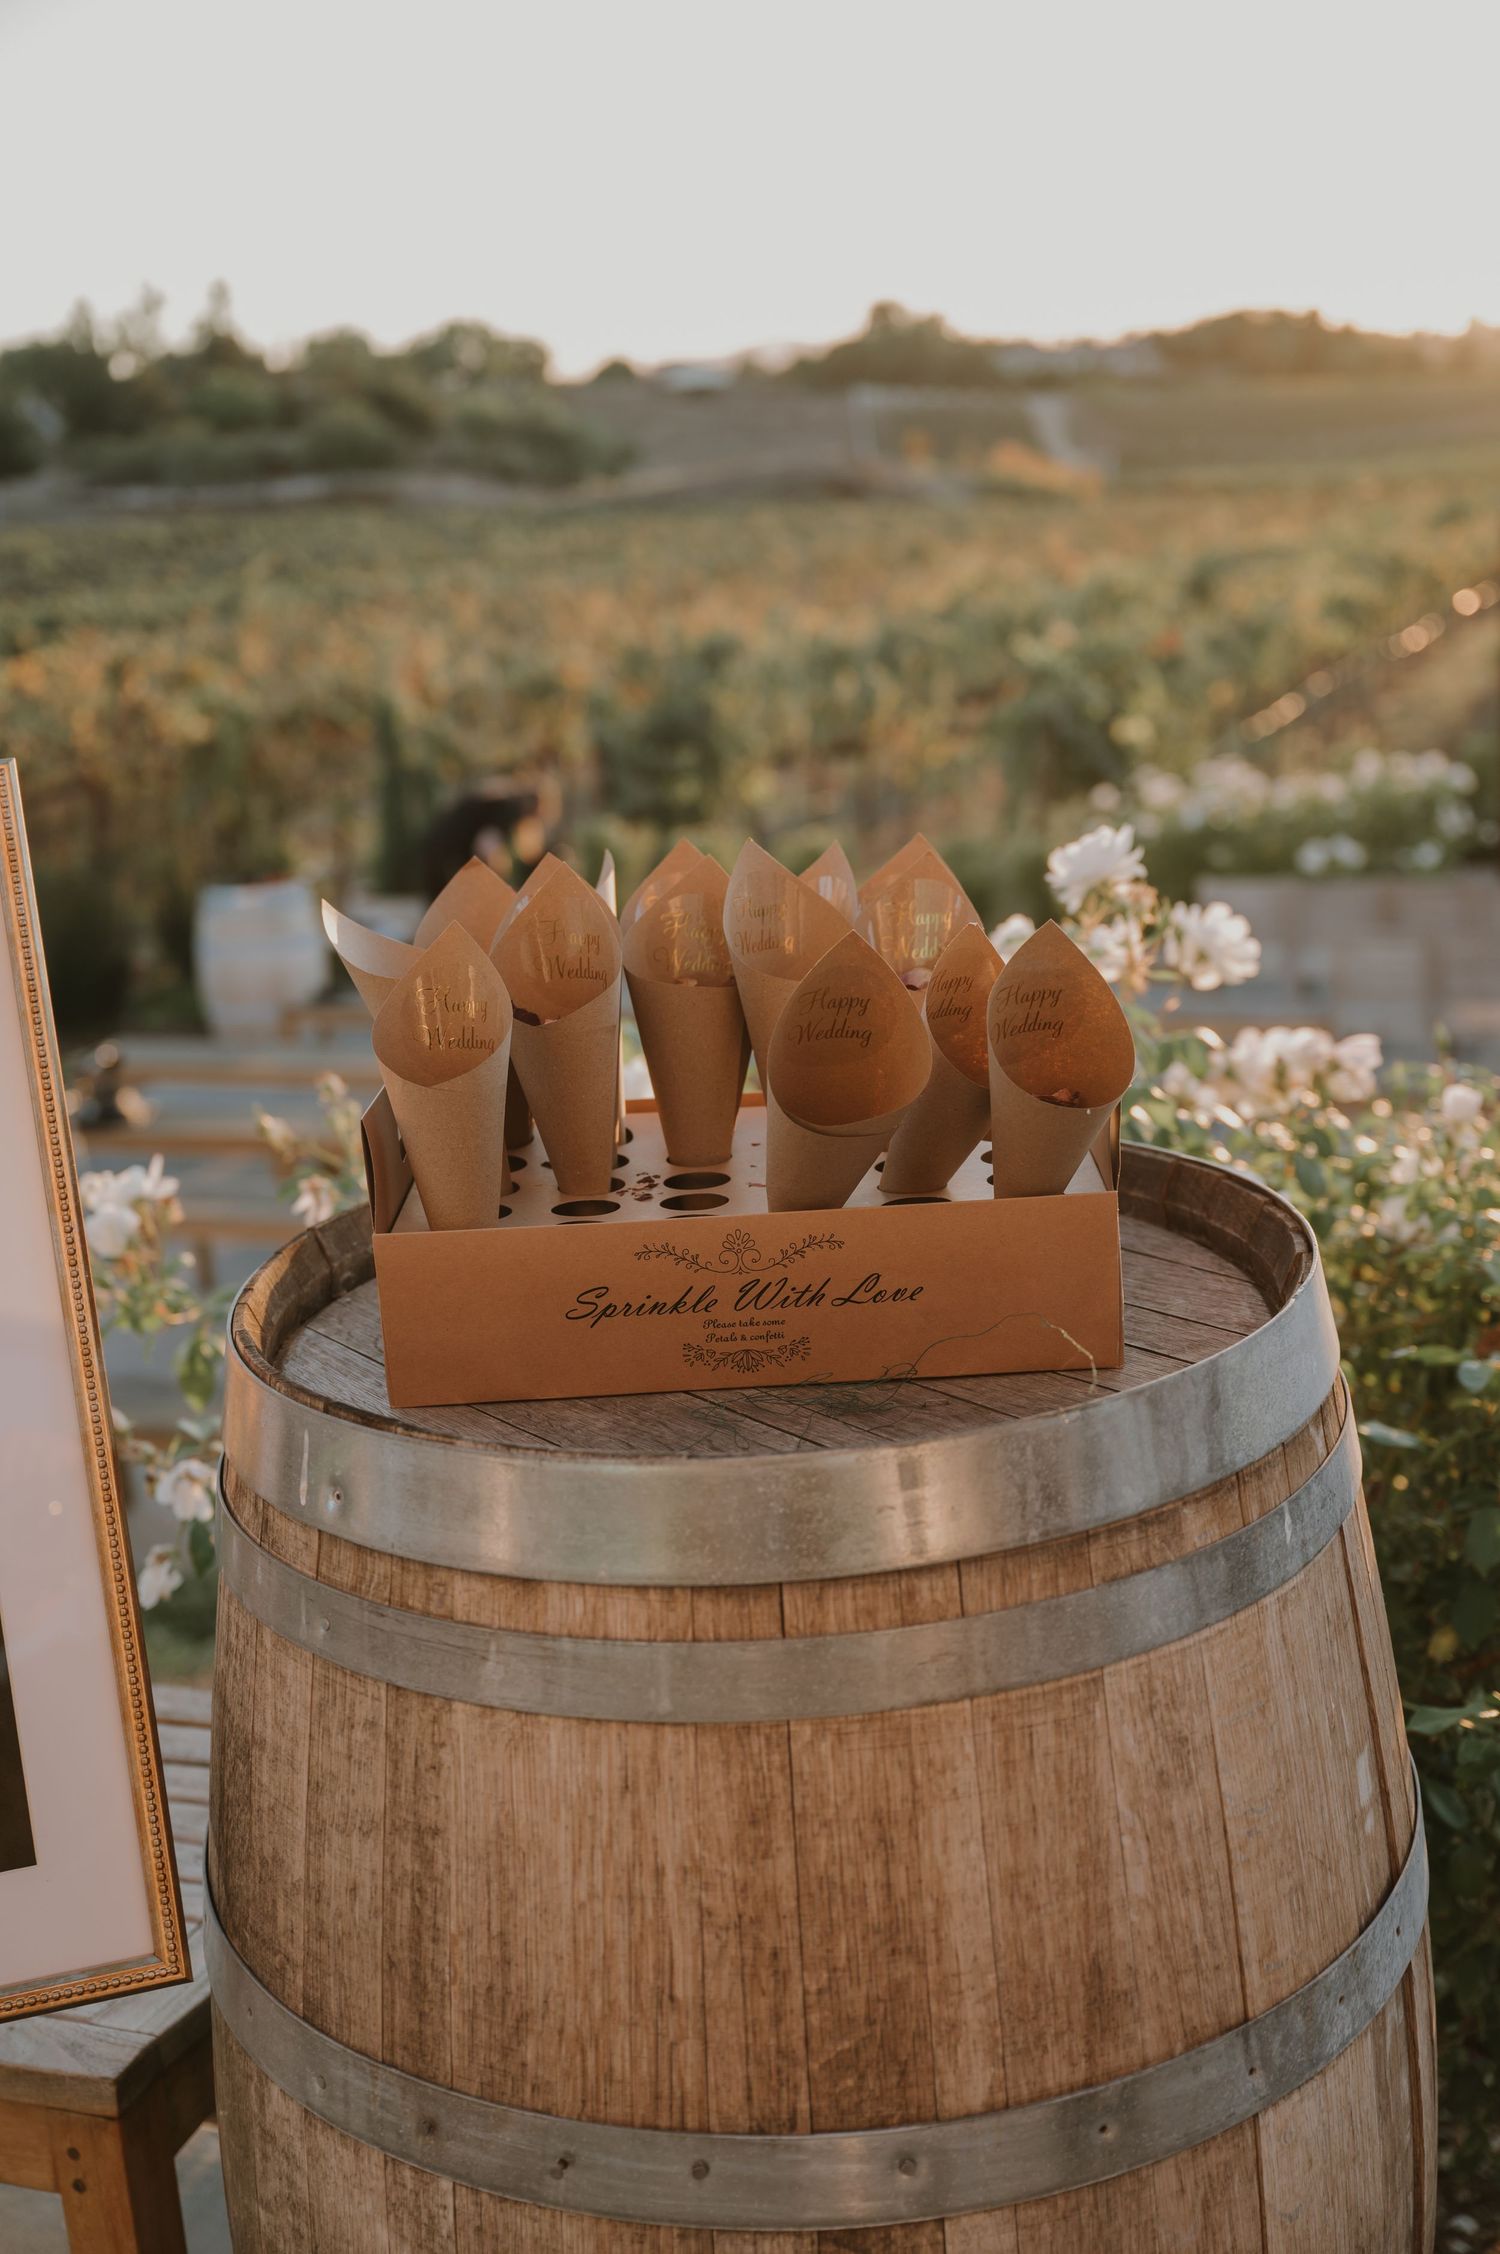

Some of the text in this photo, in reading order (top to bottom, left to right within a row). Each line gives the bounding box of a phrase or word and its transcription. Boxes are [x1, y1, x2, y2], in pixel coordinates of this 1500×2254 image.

[534, 955, 608, 991] Wedding
[799, 986, 872, 1017] Happy
[996, 981, 1065, 1013] Happy
[413, 1024, 496, 1055] Wedding
[788, 1018, 873, 1048] Wedding
[992, 1011, 1064, 1044] Wedding
[565, 1272, 925, 1329] Sprinkle With Love
[703, 1317, 786, 1330] Please take some
[705, 1330, 785, 1344] Petals & confetti
